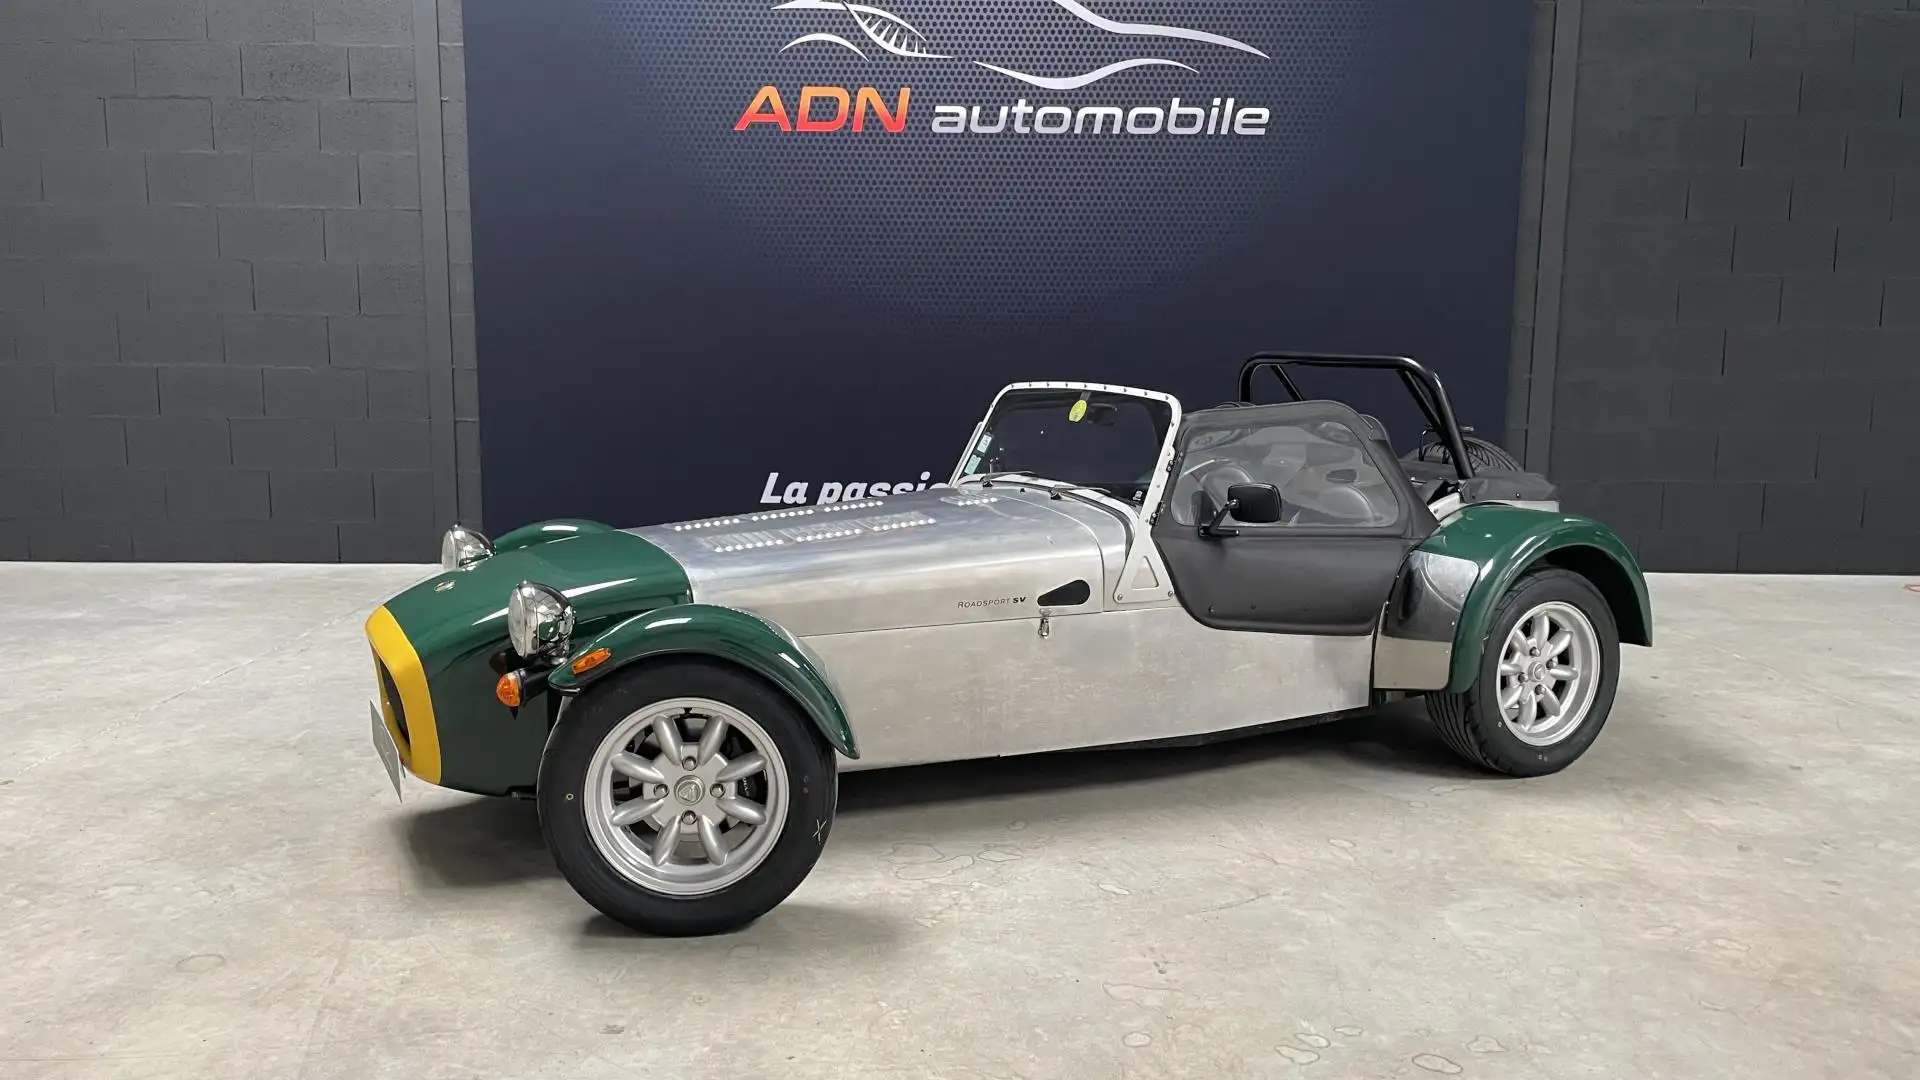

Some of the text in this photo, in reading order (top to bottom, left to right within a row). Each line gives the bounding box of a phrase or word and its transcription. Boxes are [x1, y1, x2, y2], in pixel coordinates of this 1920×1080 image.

[734, 85, 1271, 136] ADN automobile
[760, 472, 808, 504] La
[957, 596, 1027, 608] ROADSPORT SV
